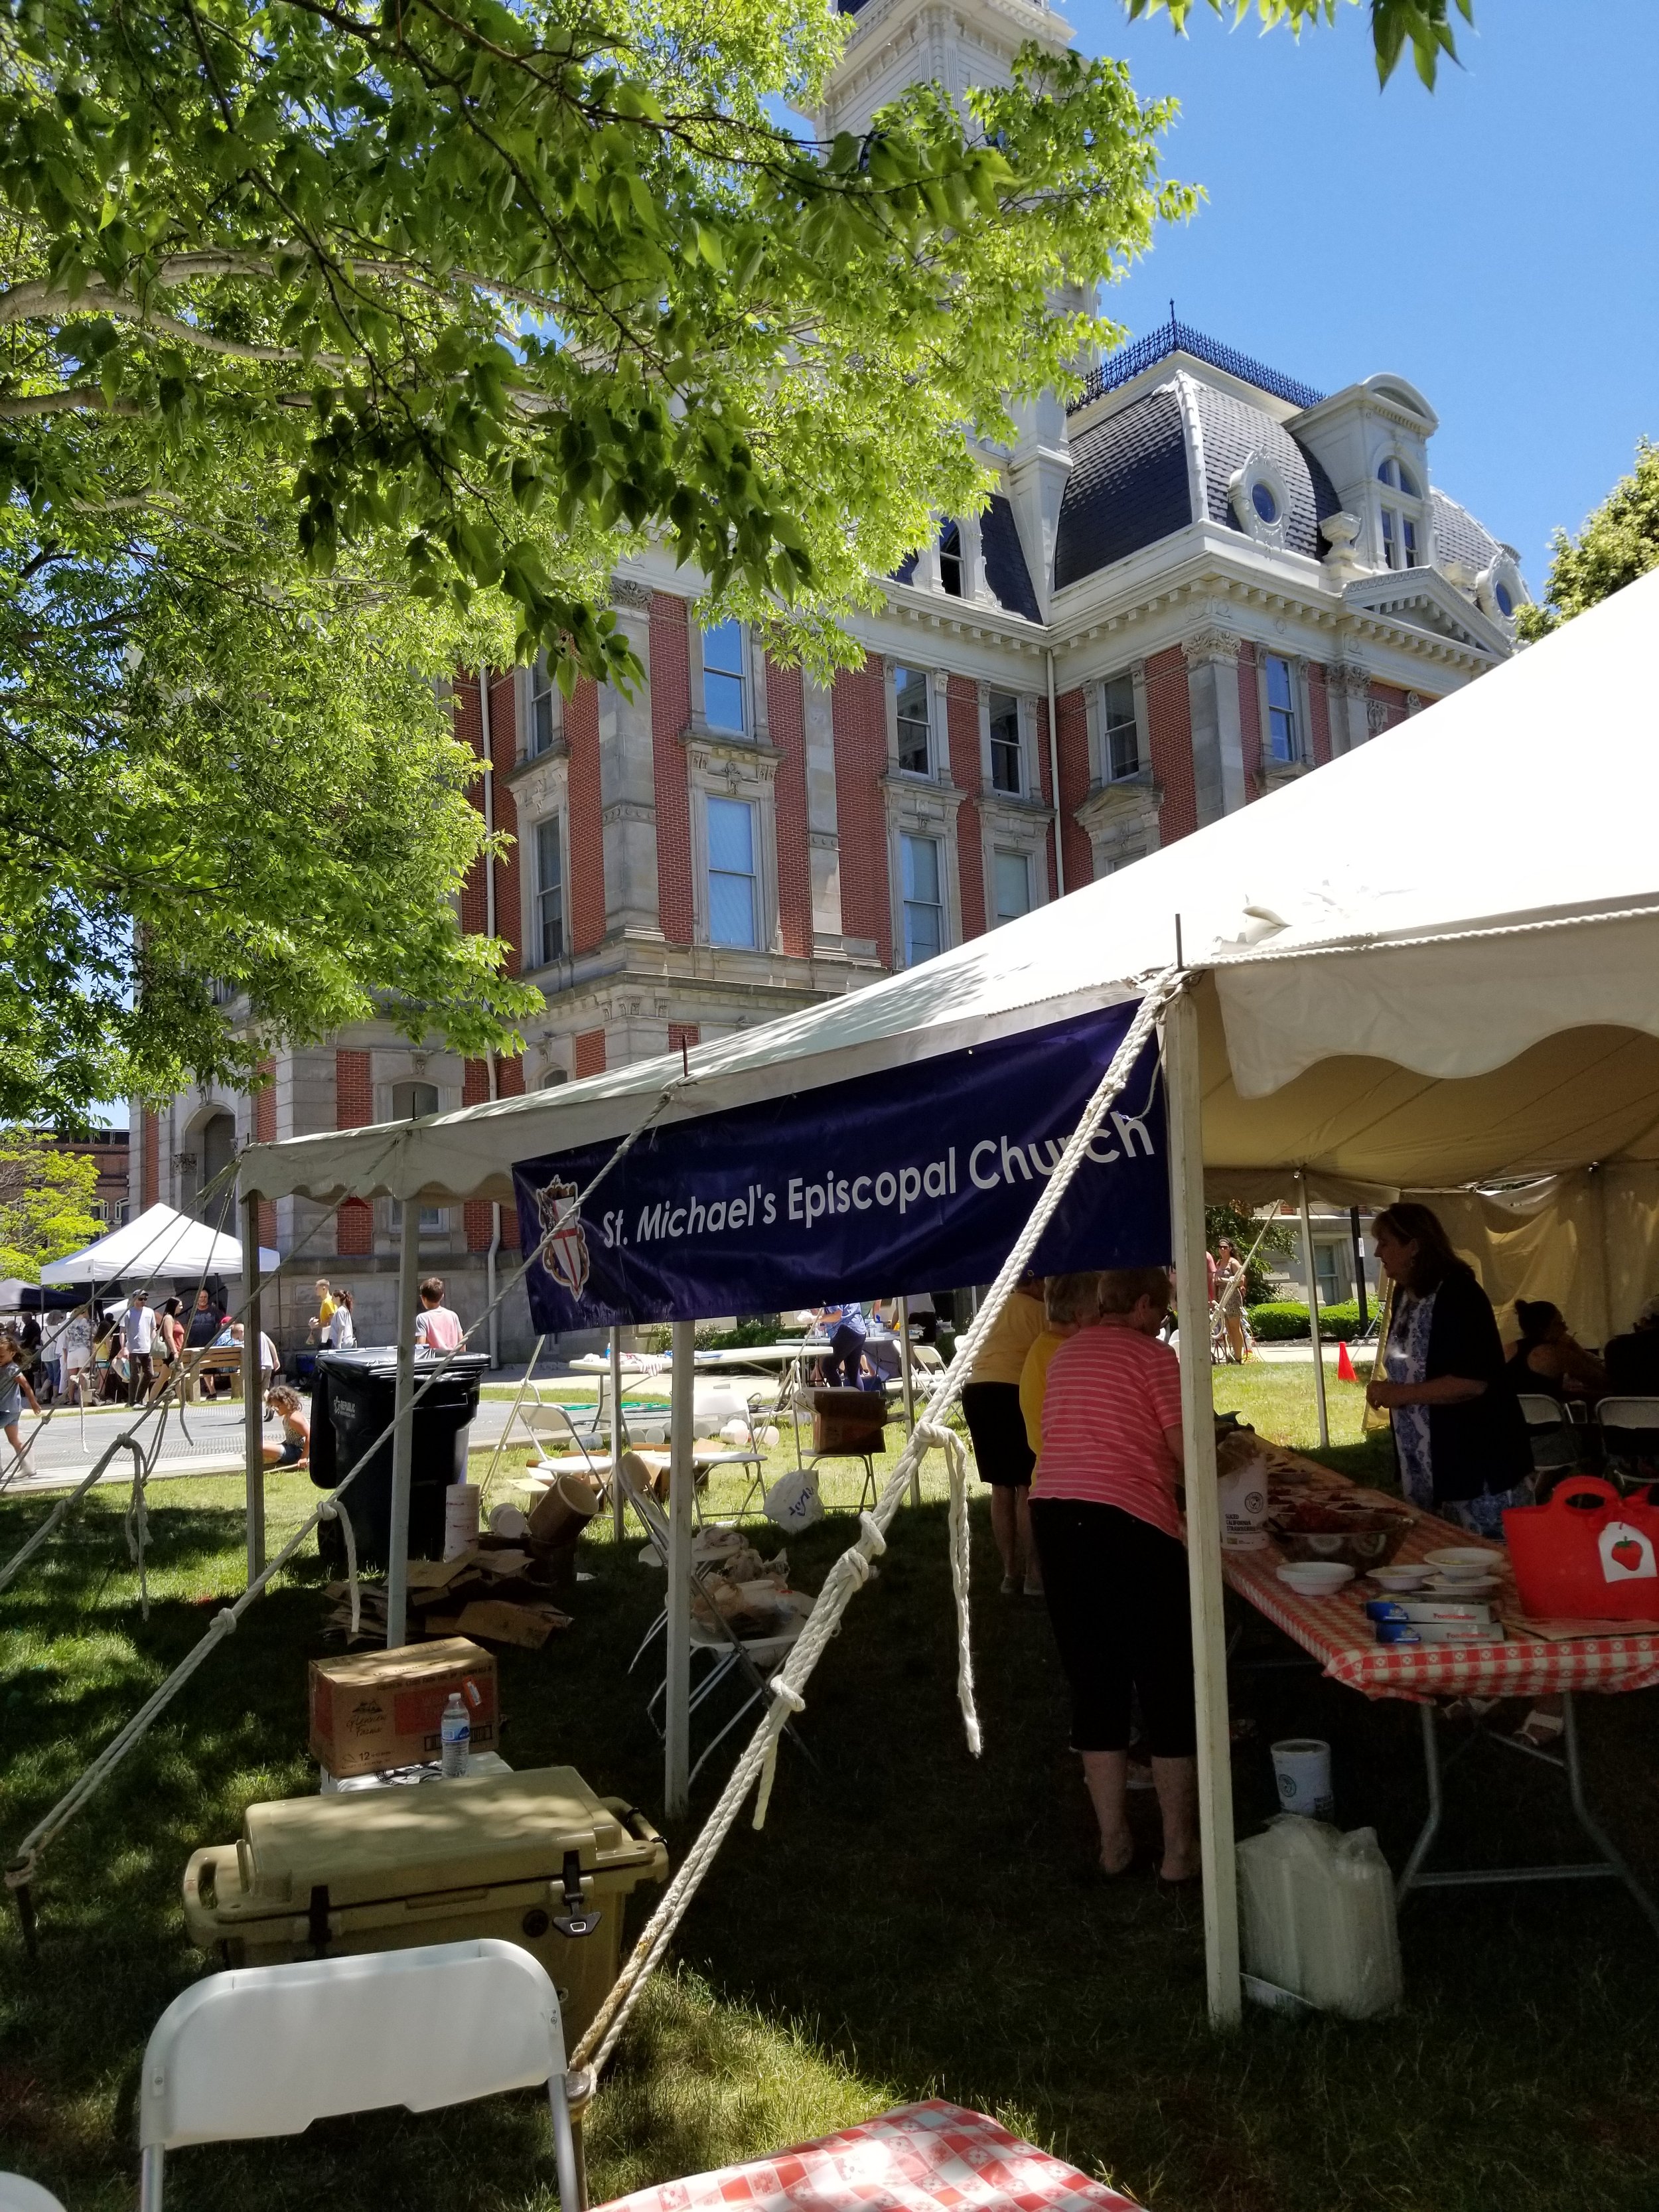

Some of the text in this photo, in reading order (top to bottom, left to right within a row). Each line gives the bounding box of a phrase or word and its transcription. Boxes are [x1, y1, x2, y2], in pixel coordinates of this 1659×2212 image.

[603, 1209, 628, 1248] St.
[636, 1184, 776, 1242] Michael's
[788, 1146, 956, 1228] Episcopal
[358, 1751, 371, 1761] 12
